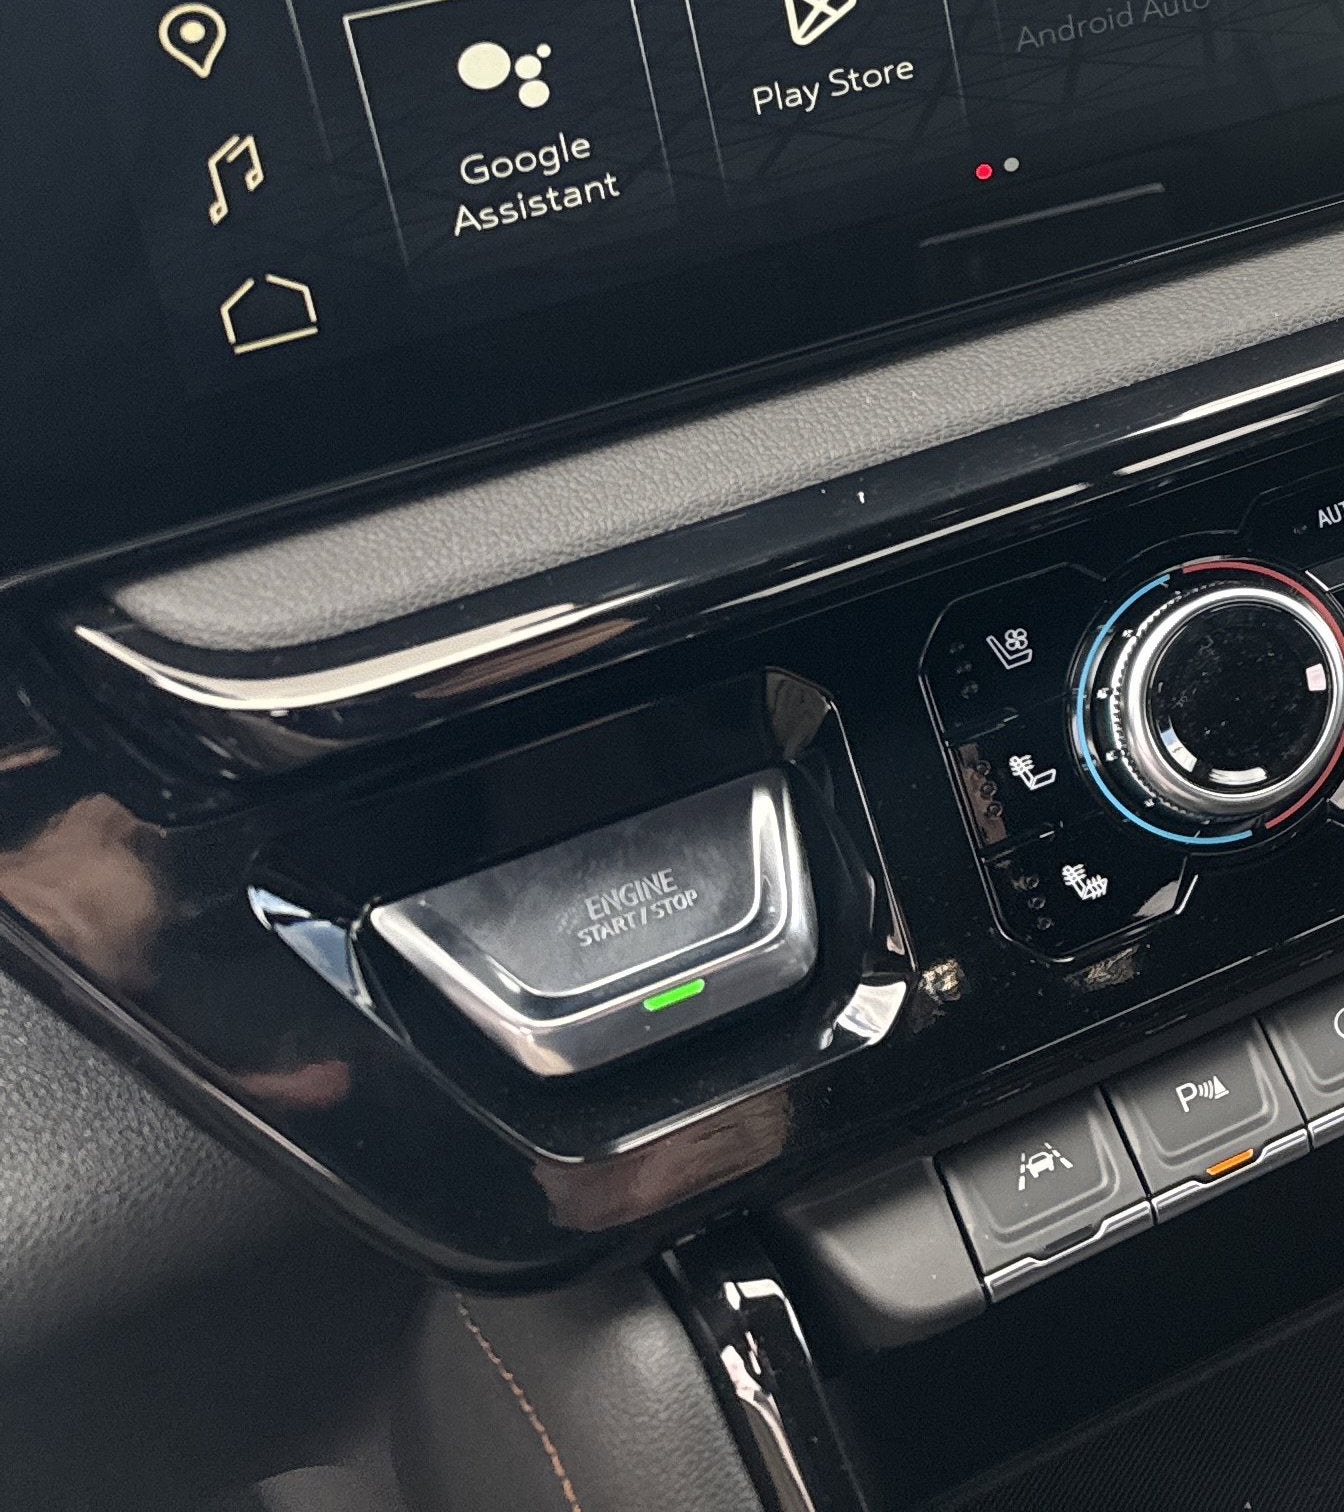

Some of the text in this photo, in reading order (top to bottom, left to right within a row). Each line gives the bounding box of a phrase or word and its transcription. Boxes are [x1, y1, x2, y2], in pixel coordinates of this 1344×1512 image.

[1016, 2, 1135, 52] Android
[753, 56, 916, 115] Play Store
[459, 130, 592, 185] Google
[453, 171, 621, 237] Assistant
[584, 868, 678, 921] ENGINE
